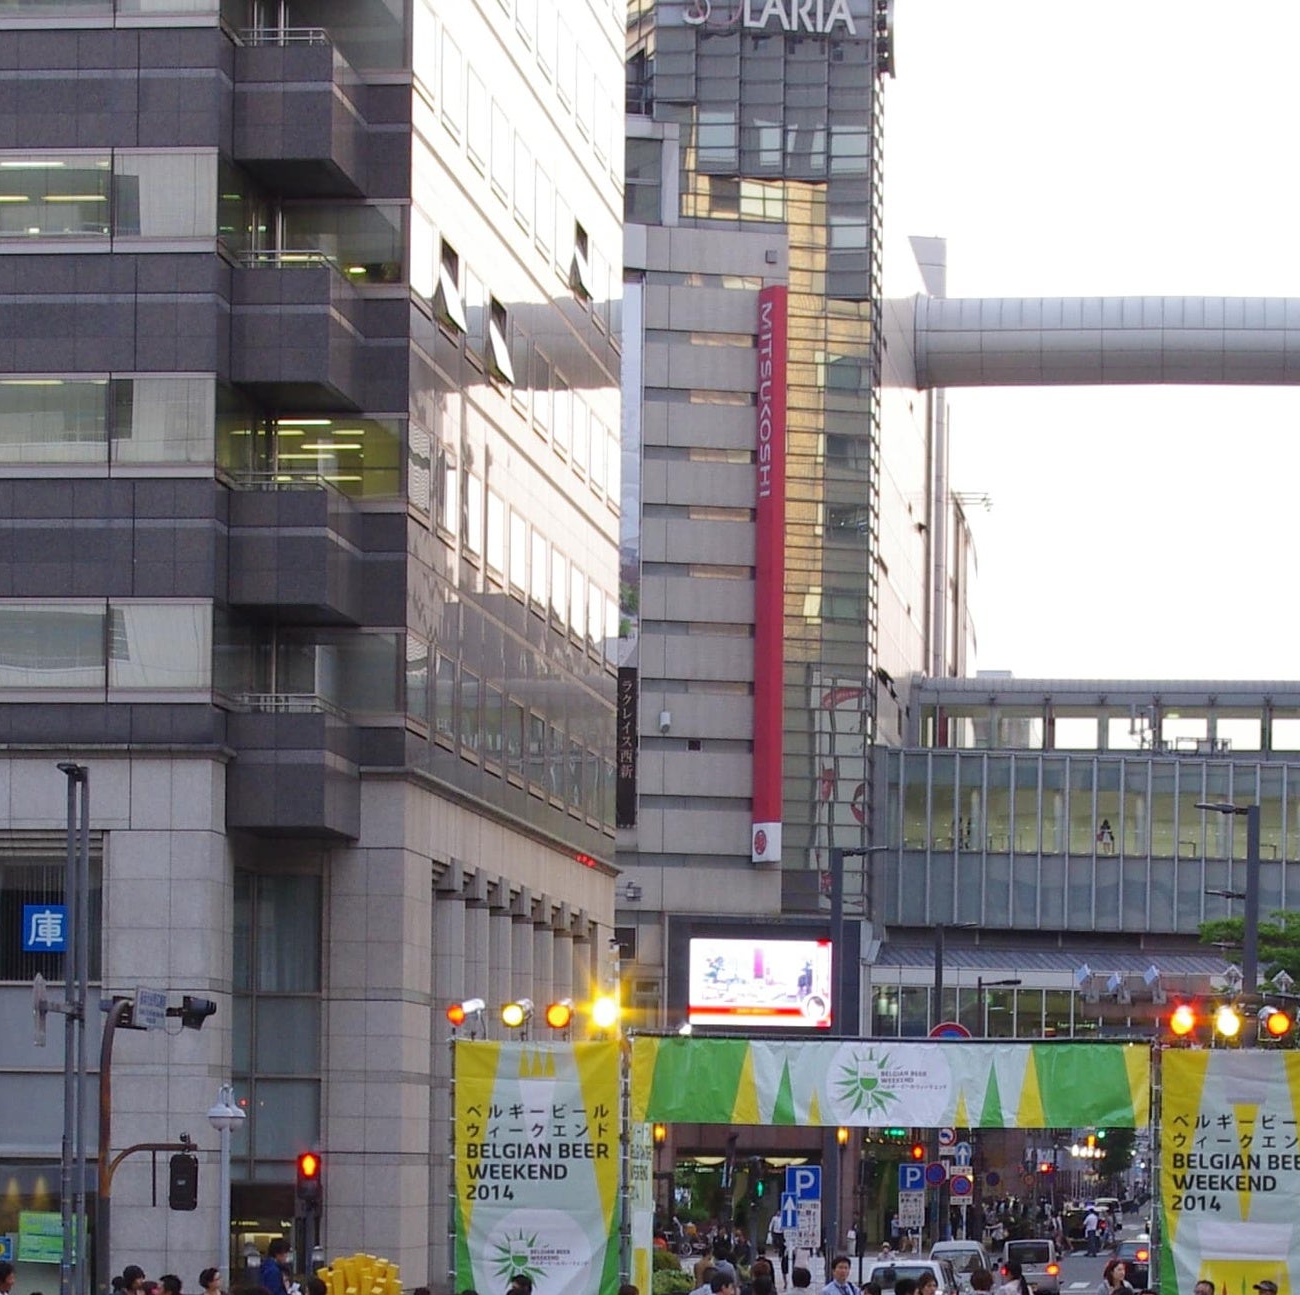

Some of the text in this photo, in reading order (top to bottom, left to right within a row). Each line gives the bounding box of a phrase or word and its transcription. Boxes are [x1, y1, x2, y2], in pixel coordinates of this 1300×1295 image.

[760, 302, 772, 497] MITSUKOSHI
[28, 910, 64, 947] 庫
[467, 1104, 609, 1119] ベルギービール
[467, 1123, 608, 1138] ウィークエンド
[467, 1143, 609, 1159] BELGIAN BEER
[1173, 1153, 1260, 1170] BELGIAN
[467, 1164, 568, 1180] WEEKEND
[906, 1167, 920, 1188] P
[796, 1170, 815, 1198] P
[1172, 1174, 1277, 1191] WEEKEND
[466, 1185, 514, 1200] 2014
[1172, 1195, 1221, 1211] 2014
